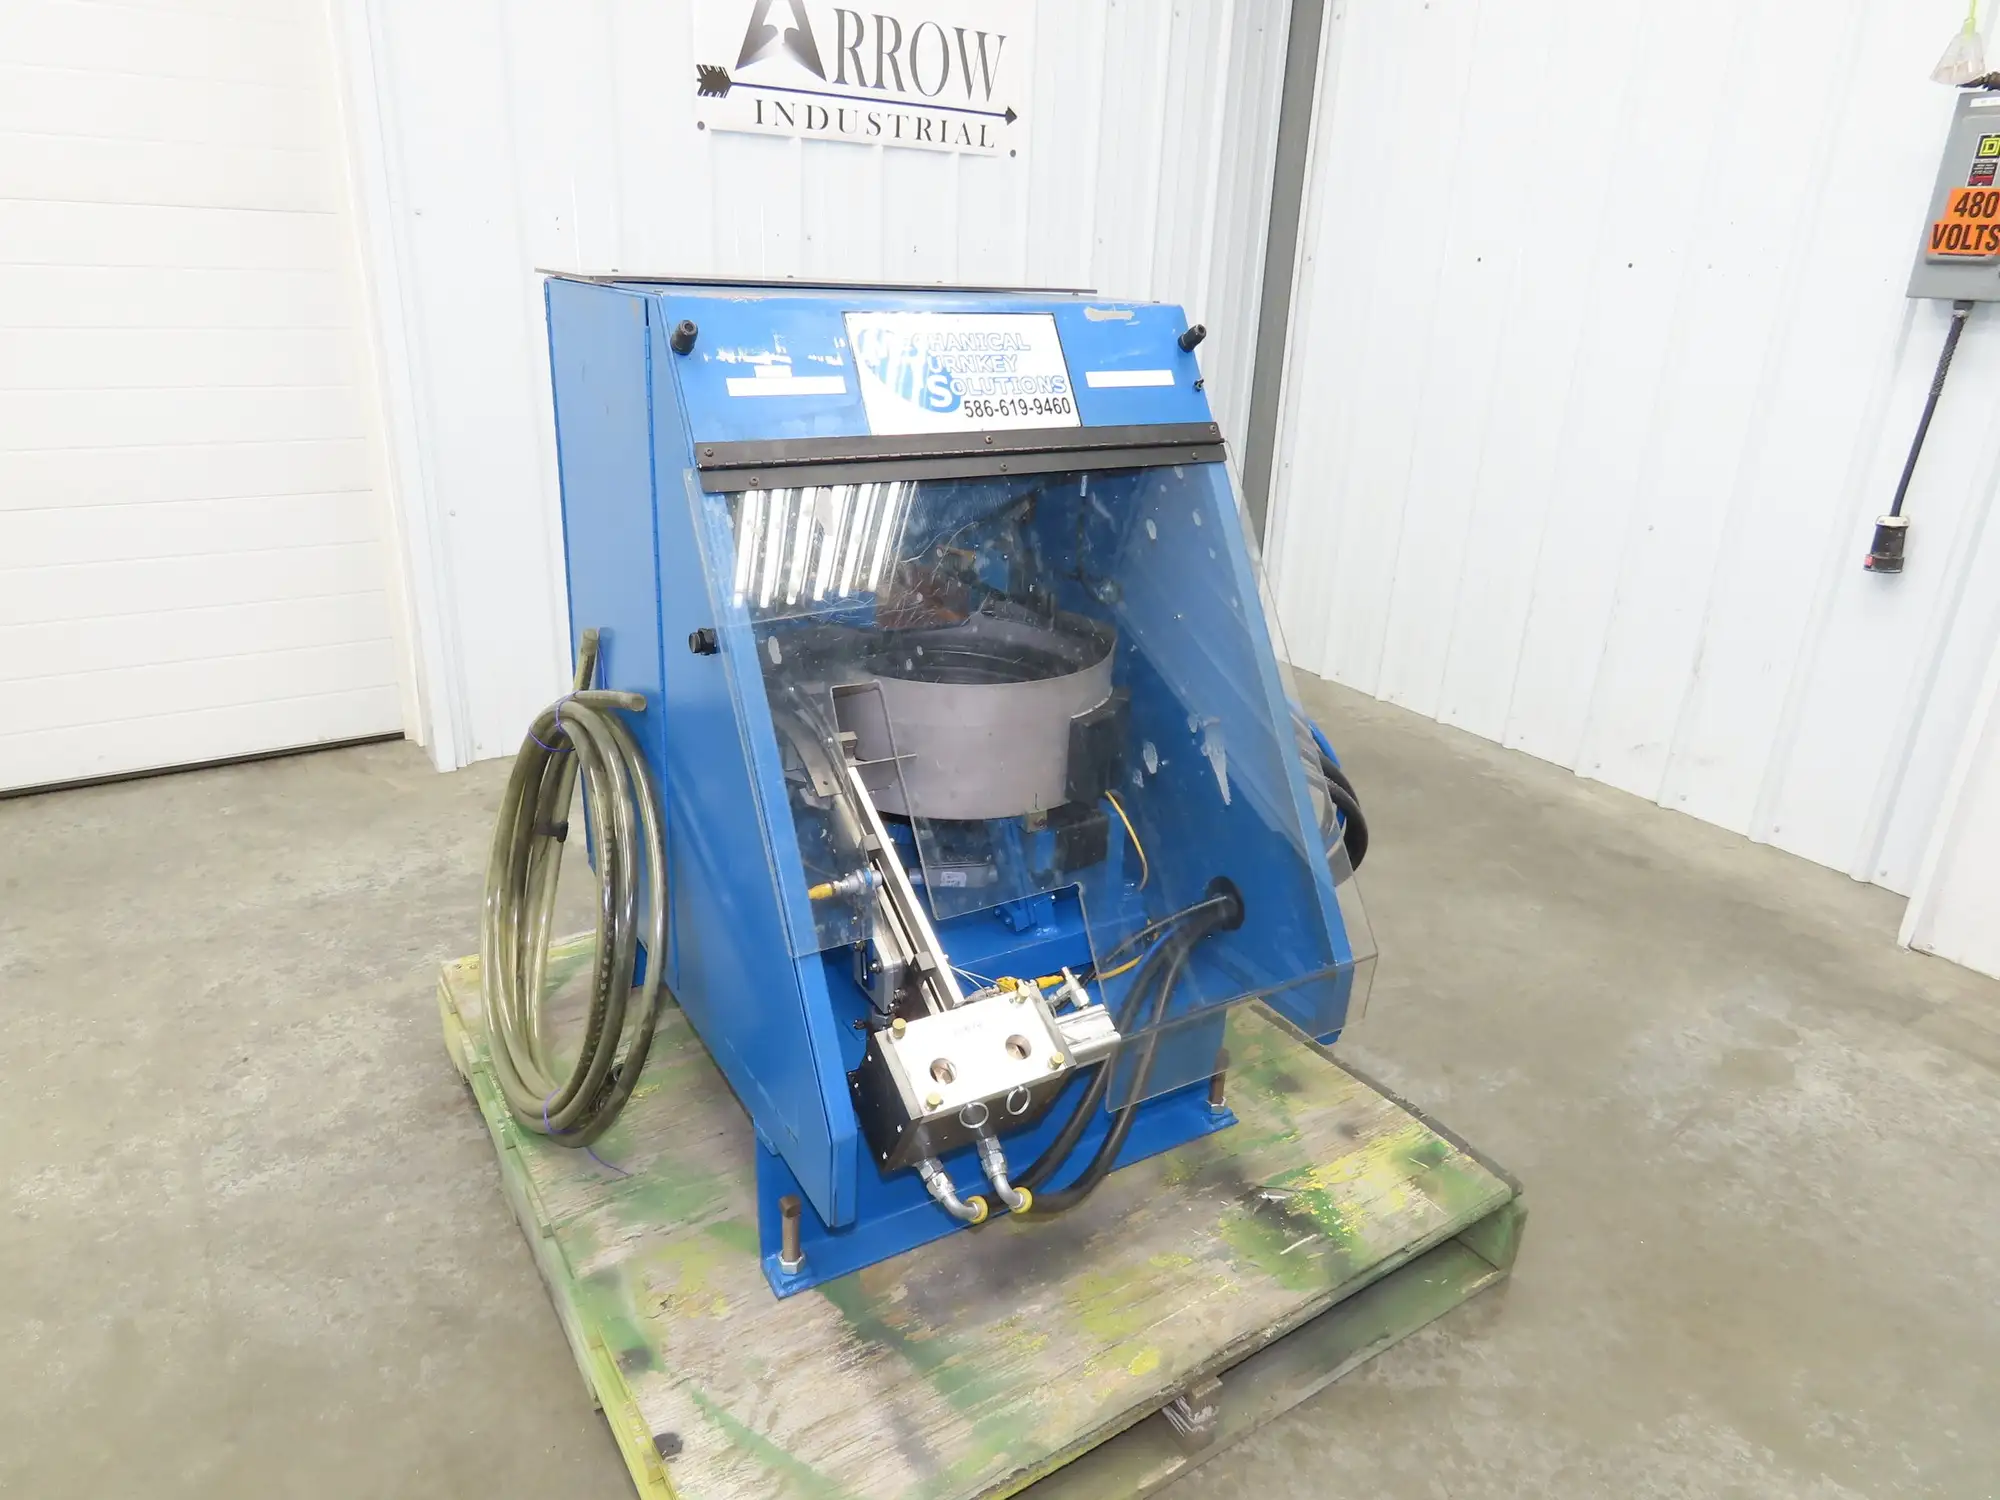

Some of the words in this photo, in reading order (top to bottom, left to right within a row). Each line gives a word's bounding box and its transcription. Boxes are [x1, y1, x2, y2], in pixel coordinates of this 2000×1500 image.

[735, 0, 1007, 102] ARROW
[753, 99, 995, 149] INDUSTRIAL
[1953, 191, 1999, 219] 480
[1932, 223, 2000, 251] VOLTS
[926, 373, 1068, 408] SOLUTIONS
[963, 396, 1072, 418] 586-619-9460
